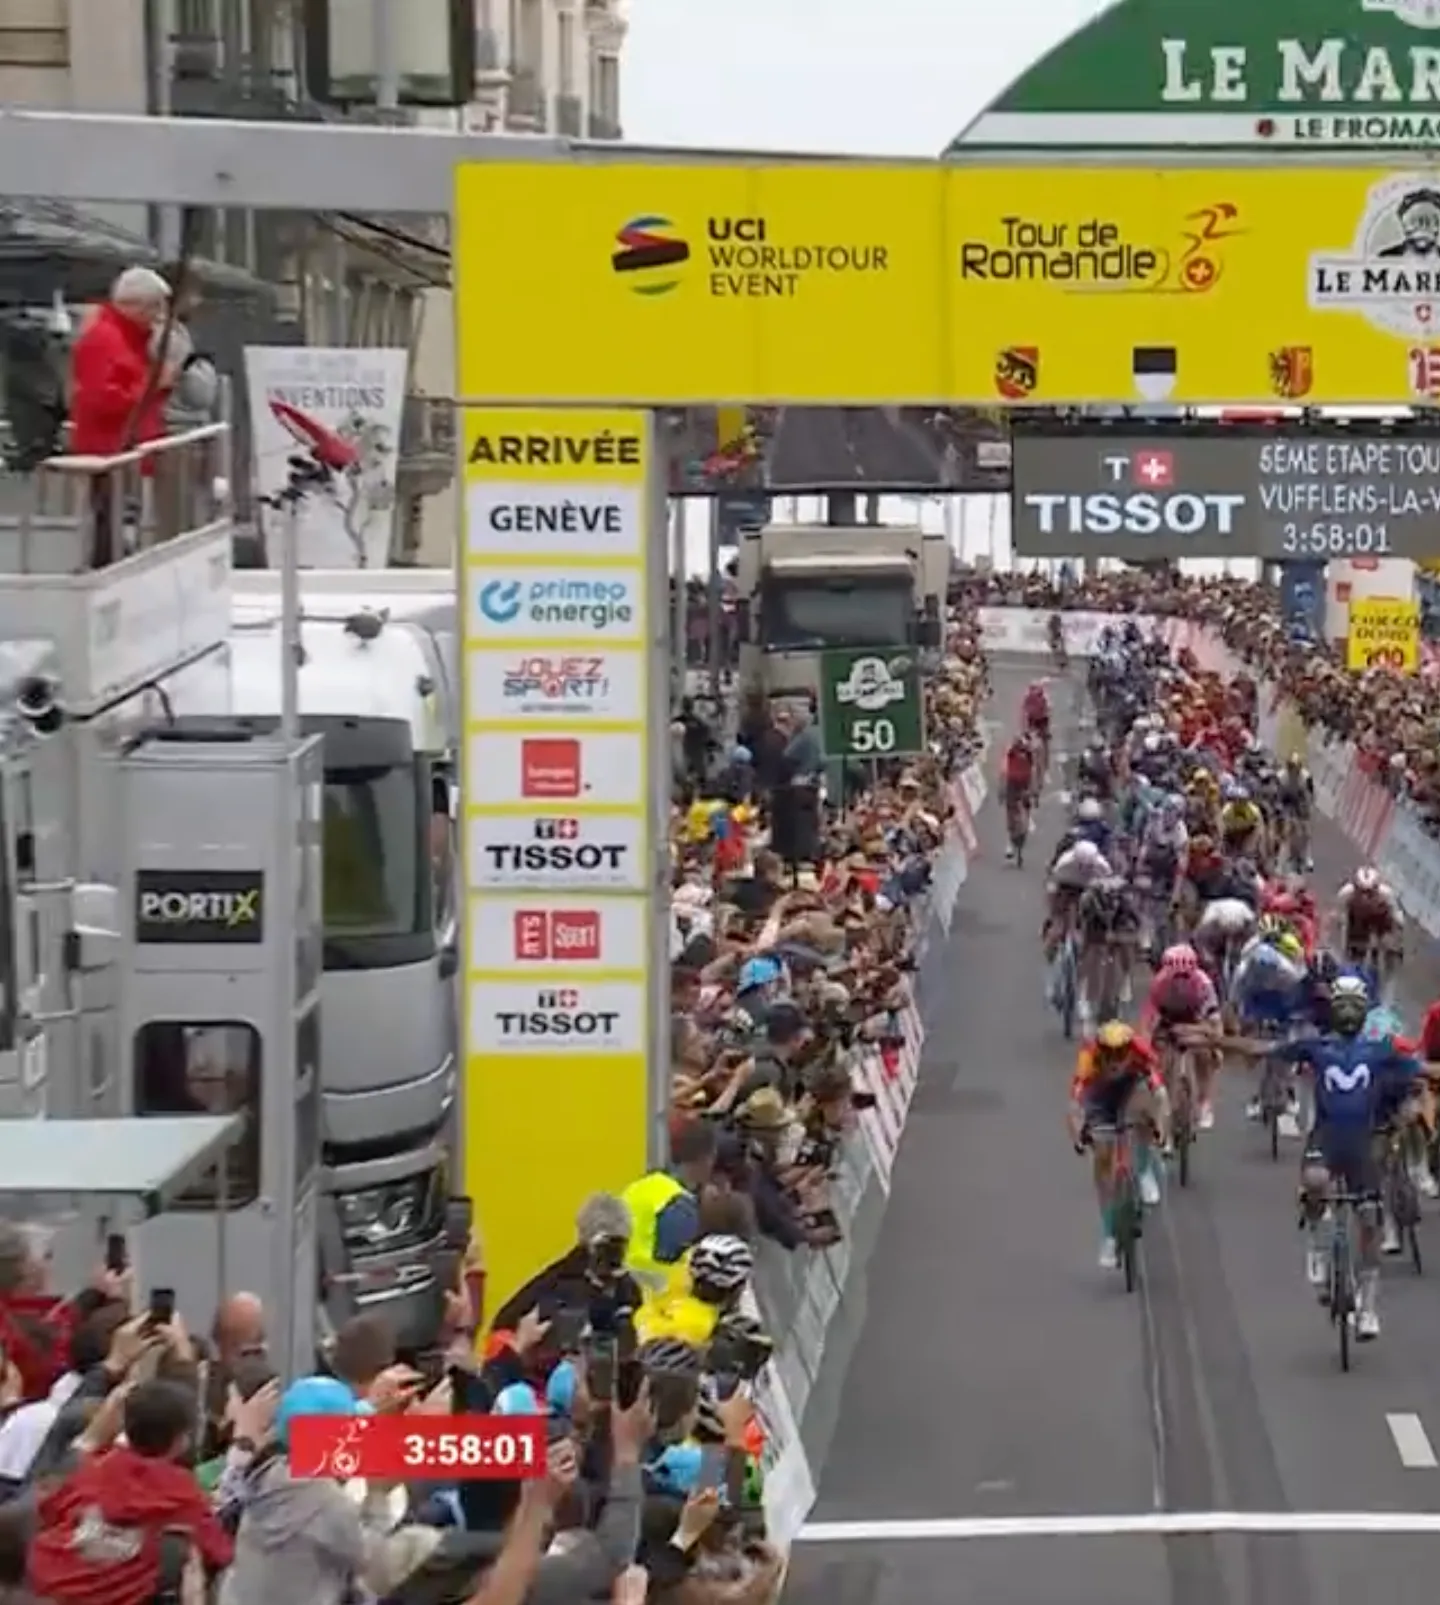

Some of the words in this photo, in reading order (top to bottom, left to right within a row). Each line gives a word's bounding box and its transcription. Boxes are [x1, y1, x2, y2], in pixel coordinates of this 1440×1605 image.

[1161, 38, 1247, 101] LE
[1295, 117, 1327, 139] LE
[708, 217, 766, 241] UCI
[1001, 216, 1068, 247] Tour
[1077, 218, 1118, 248] de
[708, 246, 888, 271] WORLDTOUR
[709, 273, 798, 297] EVENT
[1315, 268, 1351, 293] LE
[266, 386, 386, 409] VENTIONS
[468, 429, 641, 465] ARRIVÉE
[488, 499, 623, 533] GENÈVE
[1025, 493, 1246, 533] TISSOT
[1283, 523, 1391, 552] 3:58:01
[529, 578, 627, 601] primeo
[530, 603, 632, 630] energie
[504, 657, 605, 679] JOUEZ
[851, 718, 896, 752] 50
[485, 845, 628, 870] TISSOT
[141, 888, 260, 926] PORTIX
[495, 1012, 620, 1035] TISSOT
